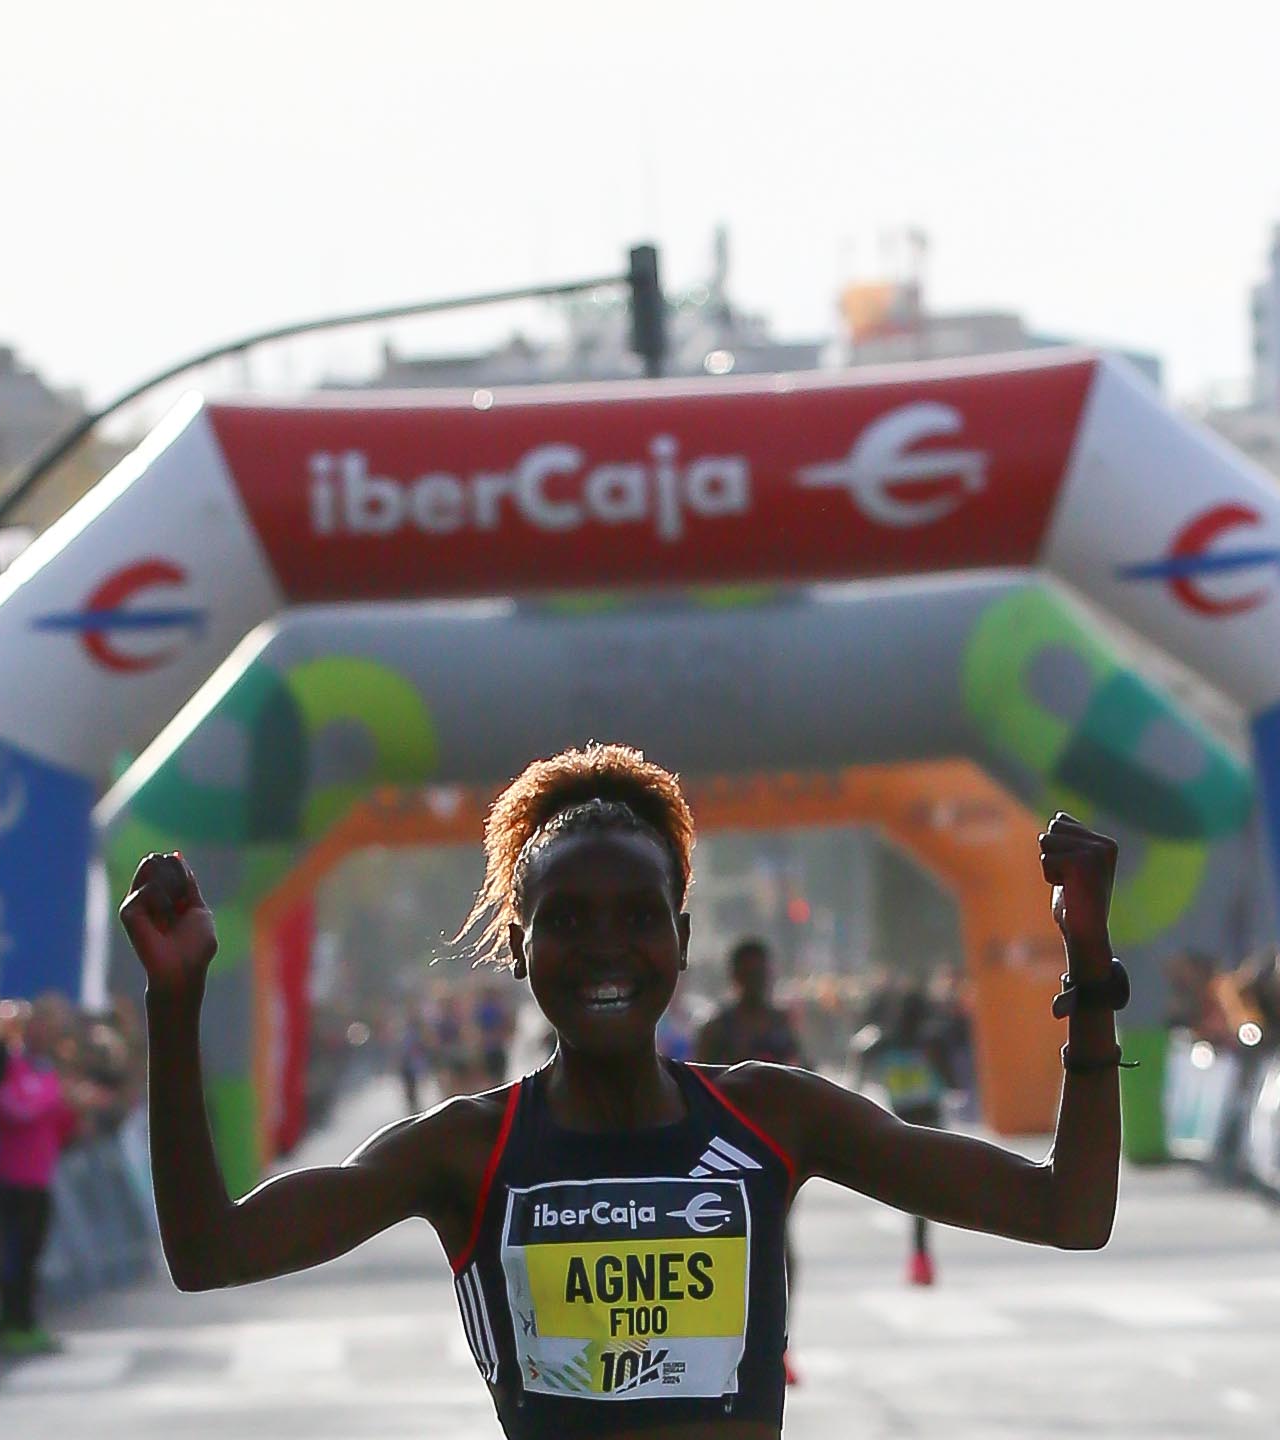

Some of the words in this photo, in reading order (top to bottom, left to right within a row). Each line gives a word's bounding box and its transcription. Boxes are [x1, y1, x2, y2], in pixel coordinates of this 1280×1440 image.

[308, 433, 750, 544] iberCaja
[533, 1199, 656, 1230] iberCaja
[565, 1252, 714, 1305] AGNES
[610, 1306, 668, 1337] F100
[600, 1349, 669, 1393] 10K
